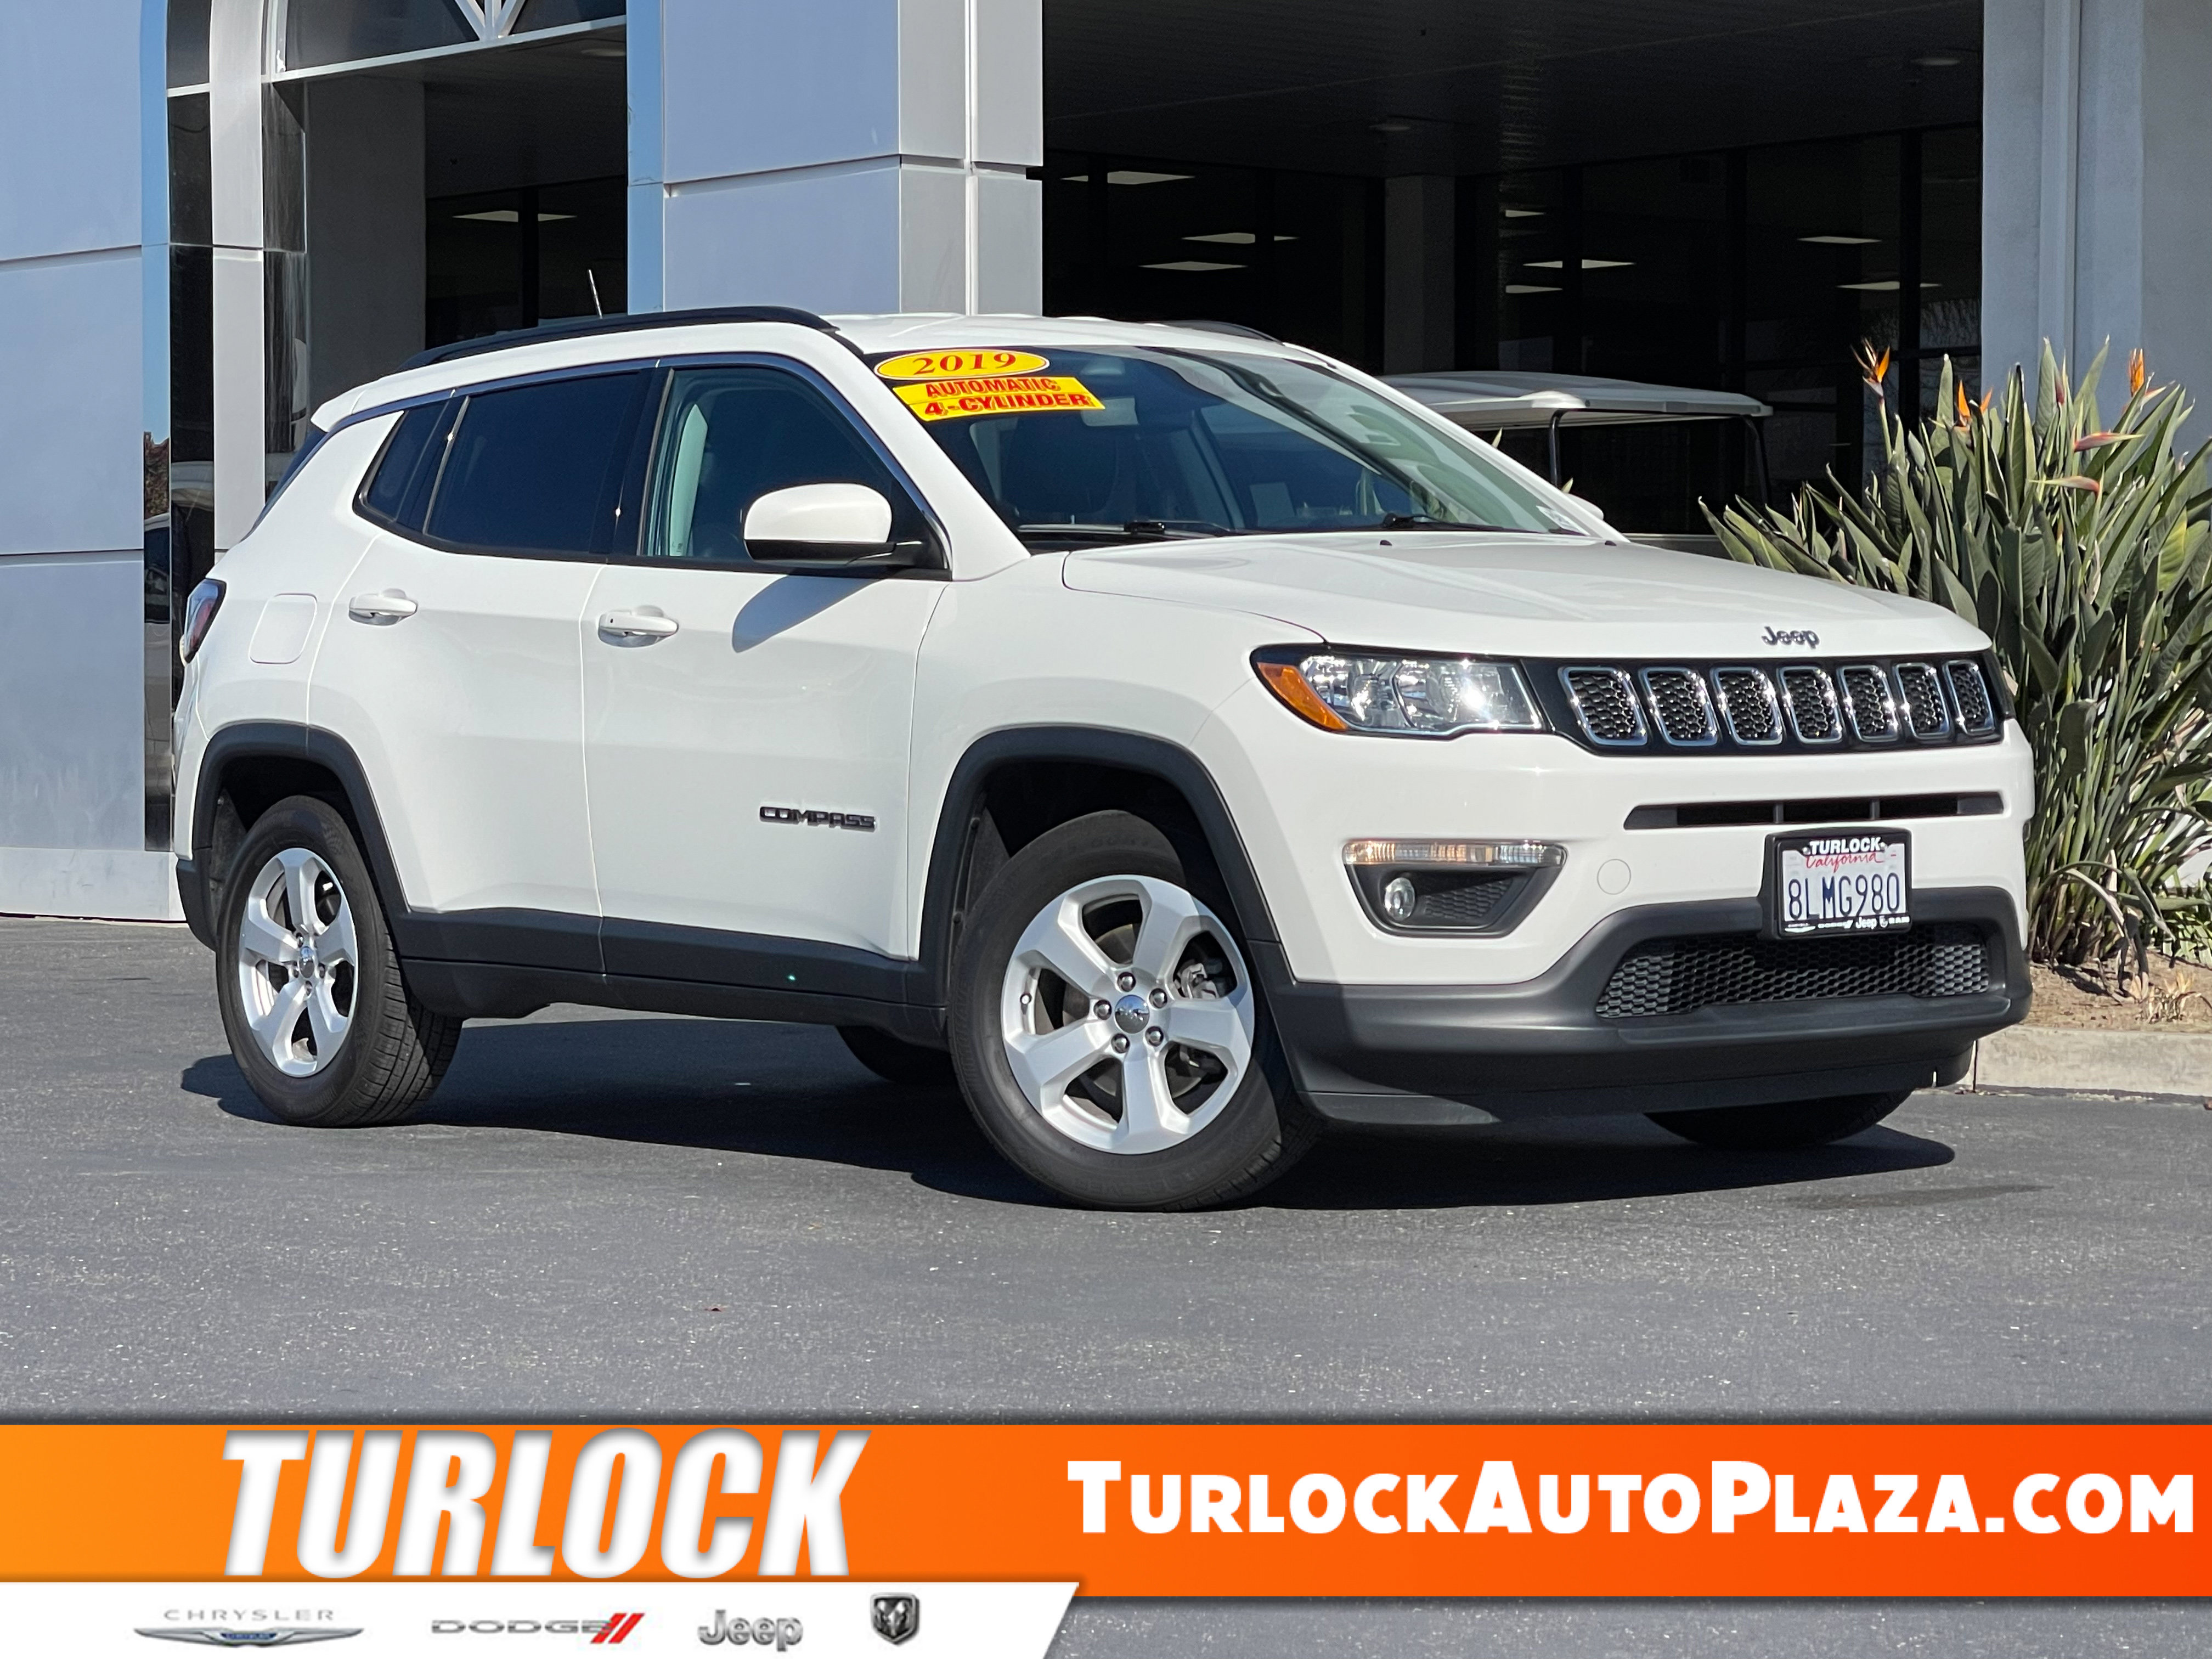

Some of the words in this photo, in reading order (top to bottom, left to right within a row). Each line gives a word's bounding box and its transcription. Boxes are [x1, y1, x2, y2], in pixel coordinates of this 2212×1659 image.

[912, 353, 1017, 375] 2019
[926, 377, 1061, 399] AUTOMATIC
[924, 393, 1095, 416] 4-CYLINDER
[1761, 626, 1820, 650] Jeep
[759, 806, 876, 833] COMPASS
[1809, 837, 1881, 854] TURLOCK
[1805, 852, 1885, 873] California
[1855, 917, 1878, 930] Jeep
